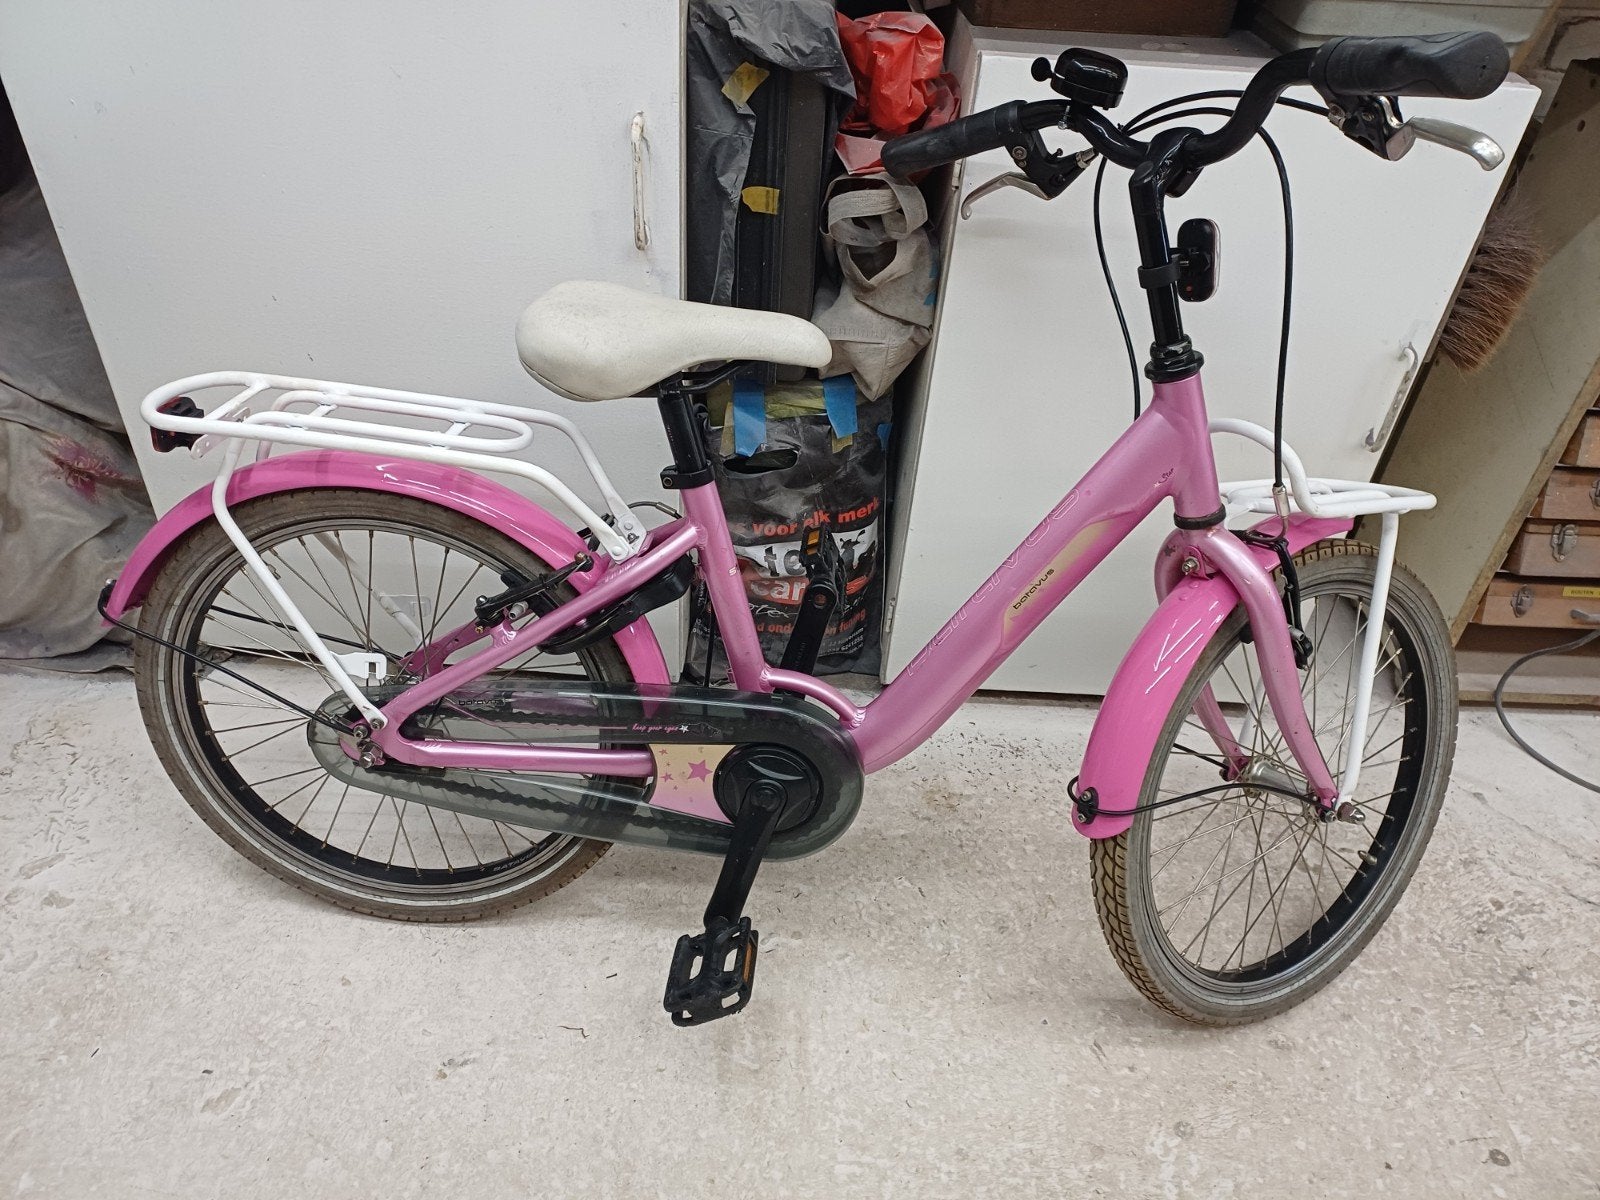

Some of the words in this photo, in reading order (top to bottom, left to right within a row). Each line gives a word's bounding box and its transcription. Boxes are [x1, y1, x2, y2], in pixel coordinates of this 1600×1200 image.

[752, 521, 798, 537] voor
[803, 509, 831, 528] elk
[1013, 568, 1055, 610] batavus
